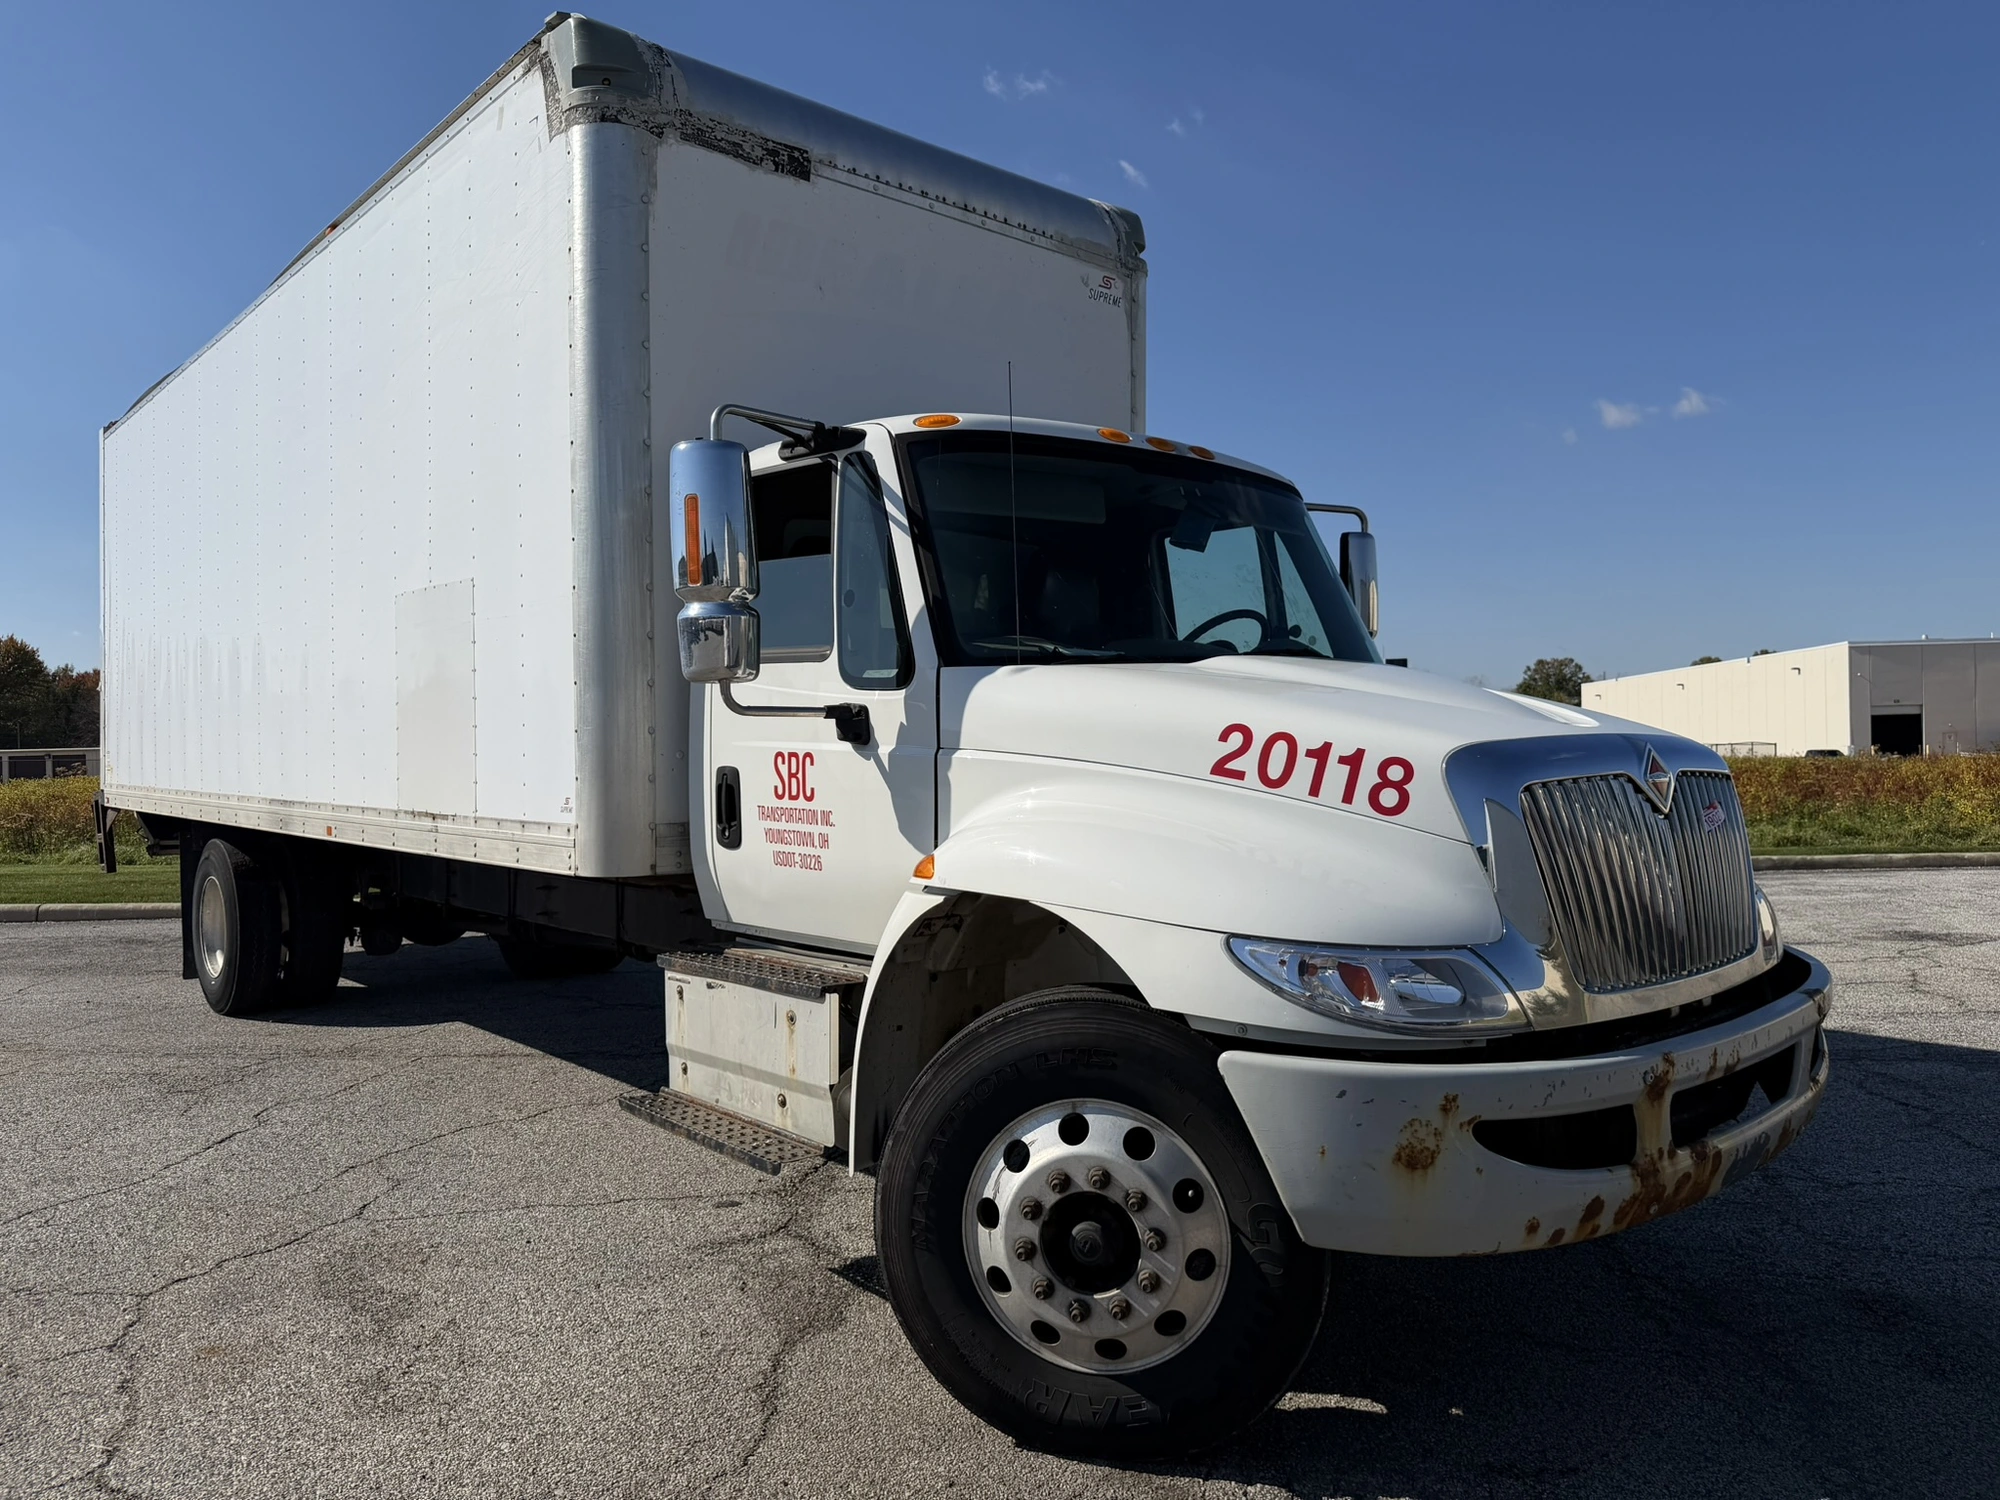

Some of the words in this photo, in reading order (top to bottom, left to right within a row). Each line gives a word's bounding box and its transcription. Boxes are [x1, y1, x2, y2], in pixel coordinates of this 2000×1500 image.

[1088, 288, 1122, 308] SUPREME
[773, 751, 815, 802] SBC
[1209, 723, 1415, 817] 20118
[757, 805, 819, 826] TRANSPORTATION
[820, 810, 836, 827] INC.
[764, 827, 818, 849] YOUNGSTOWN,
[818, 832, 830, 849] OH
[772, 850, 823, 871] USDOT-30226
[910, 1061, 1020, 1253] MARATHON
[1035, 1047, 1118, 1071] LHS
